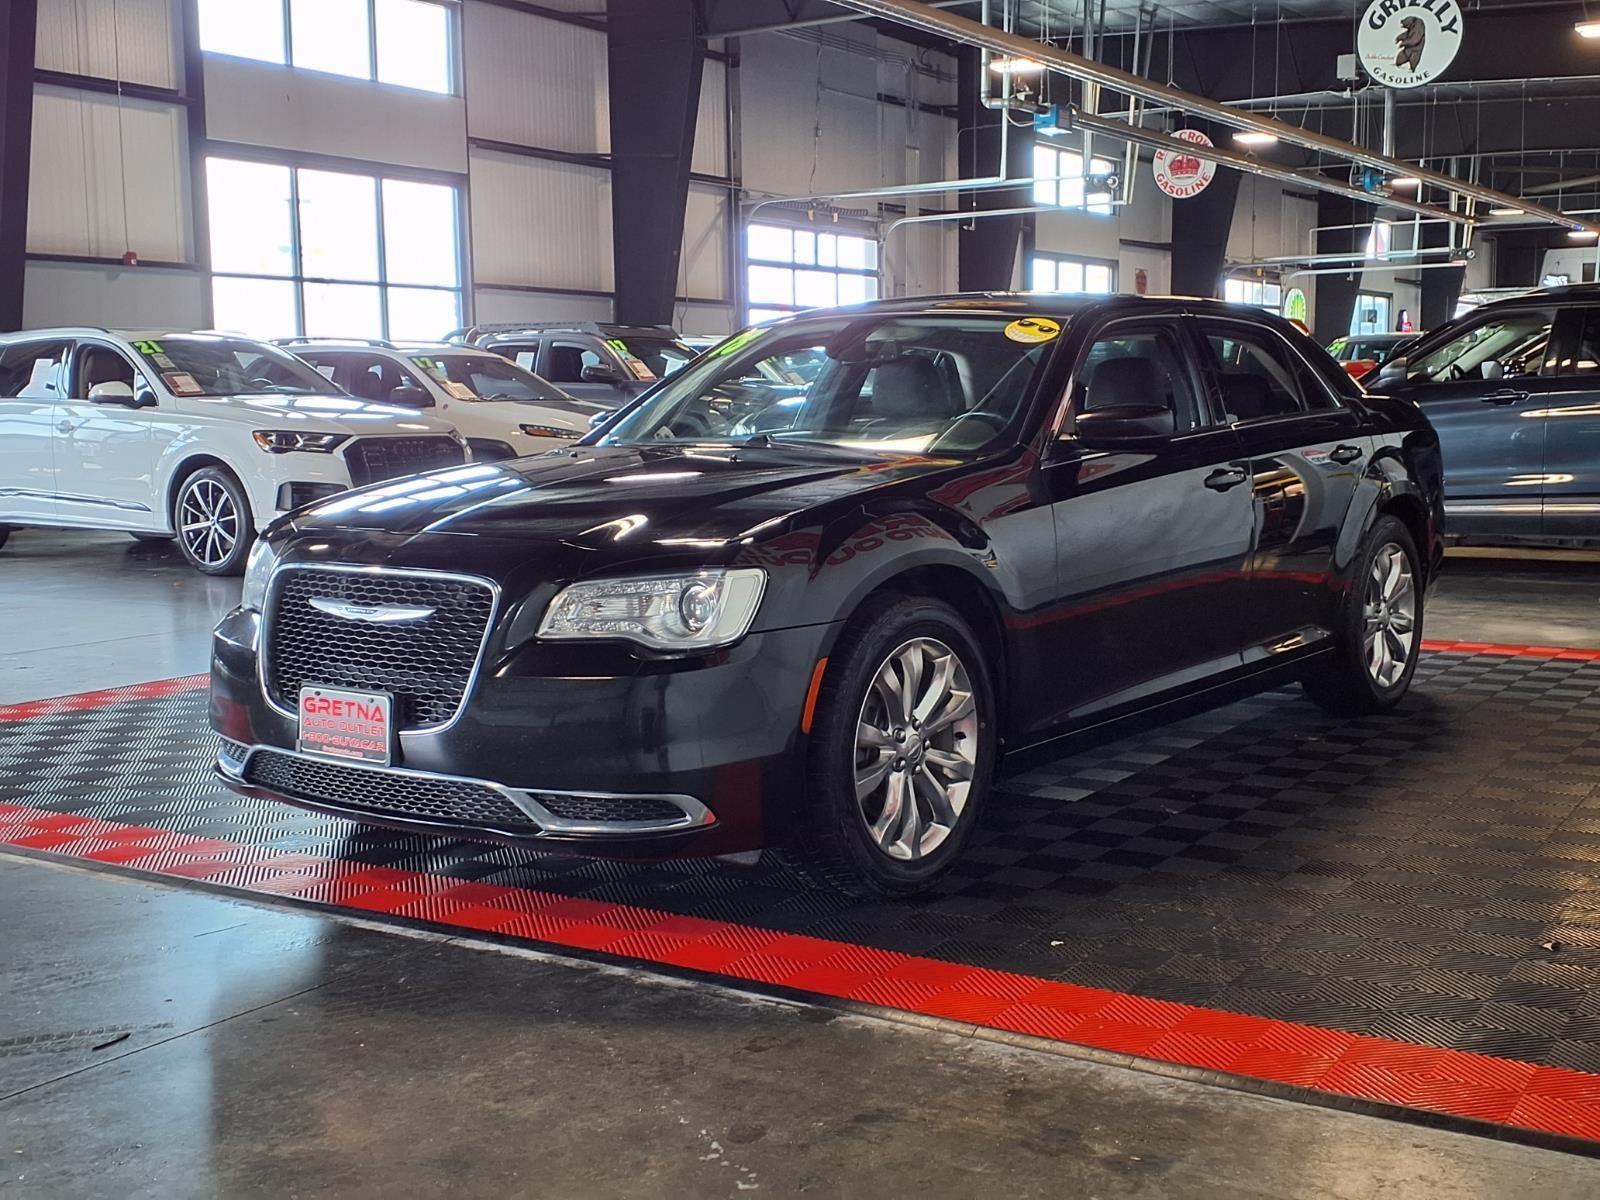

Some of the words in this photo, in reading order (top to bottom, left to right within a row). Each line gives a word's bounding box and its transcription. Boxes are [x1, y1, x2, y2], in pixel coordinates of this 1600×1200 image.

[1373, 67, 1430, 84] GASOLINE
[1179, 131, 1211, 147] CRO
[1156, 171, 1211, 196] GASOLINE
[134, 340, 164, 354] 21
[303, 697, 385, 722] GRETNA
[304, 717, 336, 728] AUTO
[339, 721, 385, 736] OUTLET
